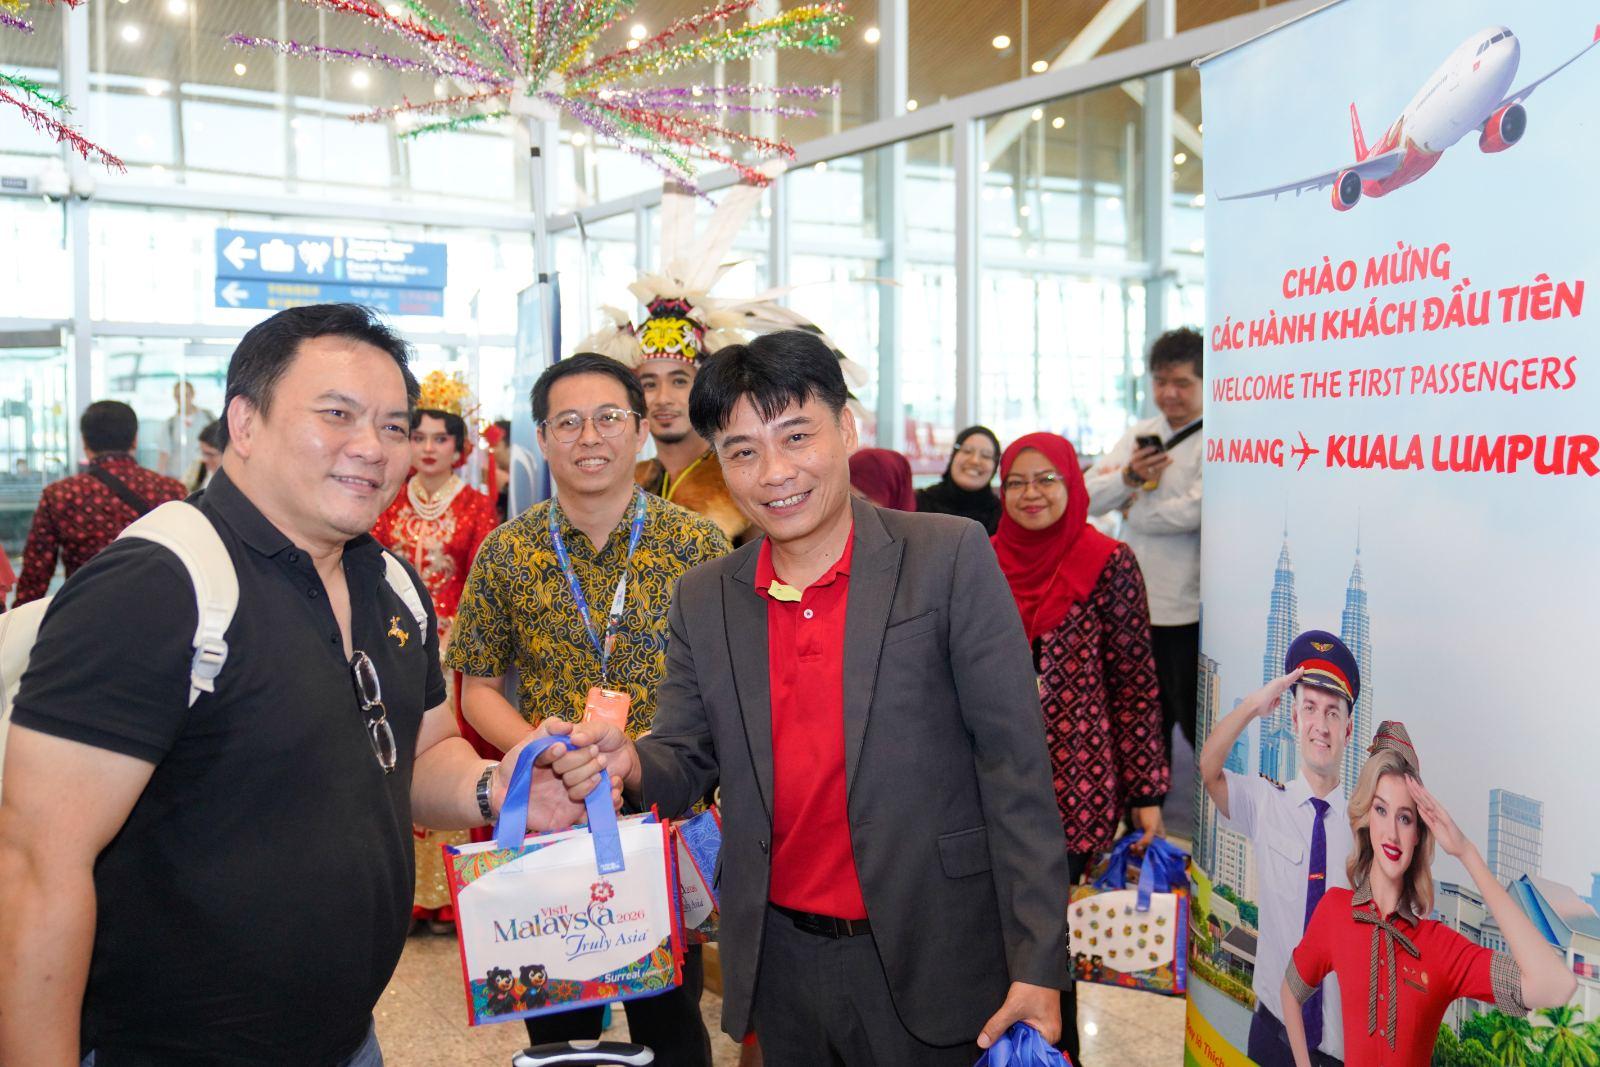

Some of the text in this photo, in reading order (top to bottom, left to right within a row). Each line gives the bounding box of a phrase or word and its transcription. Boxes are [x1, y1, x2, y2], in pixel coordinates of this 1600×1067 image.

[1282, 240, 1451, 299] CHÀO MỪNG
[1211, 272, 1585, 352] CÁC HÀNH KHÁCH ĐẦU TIÊN
[1212, 355, 1578, 402] WELCOME THE FIRST PASSENGERS
[1206, 434, 1600, 477] DA NANG KUALA LUMPUR
[493, 902, 645, 943] Malaysia 2026
[541, 904, 569, 918] Visit
[565, 928, 647, 960] Truly Asia
[604, 969, 641, 984] Surreal
